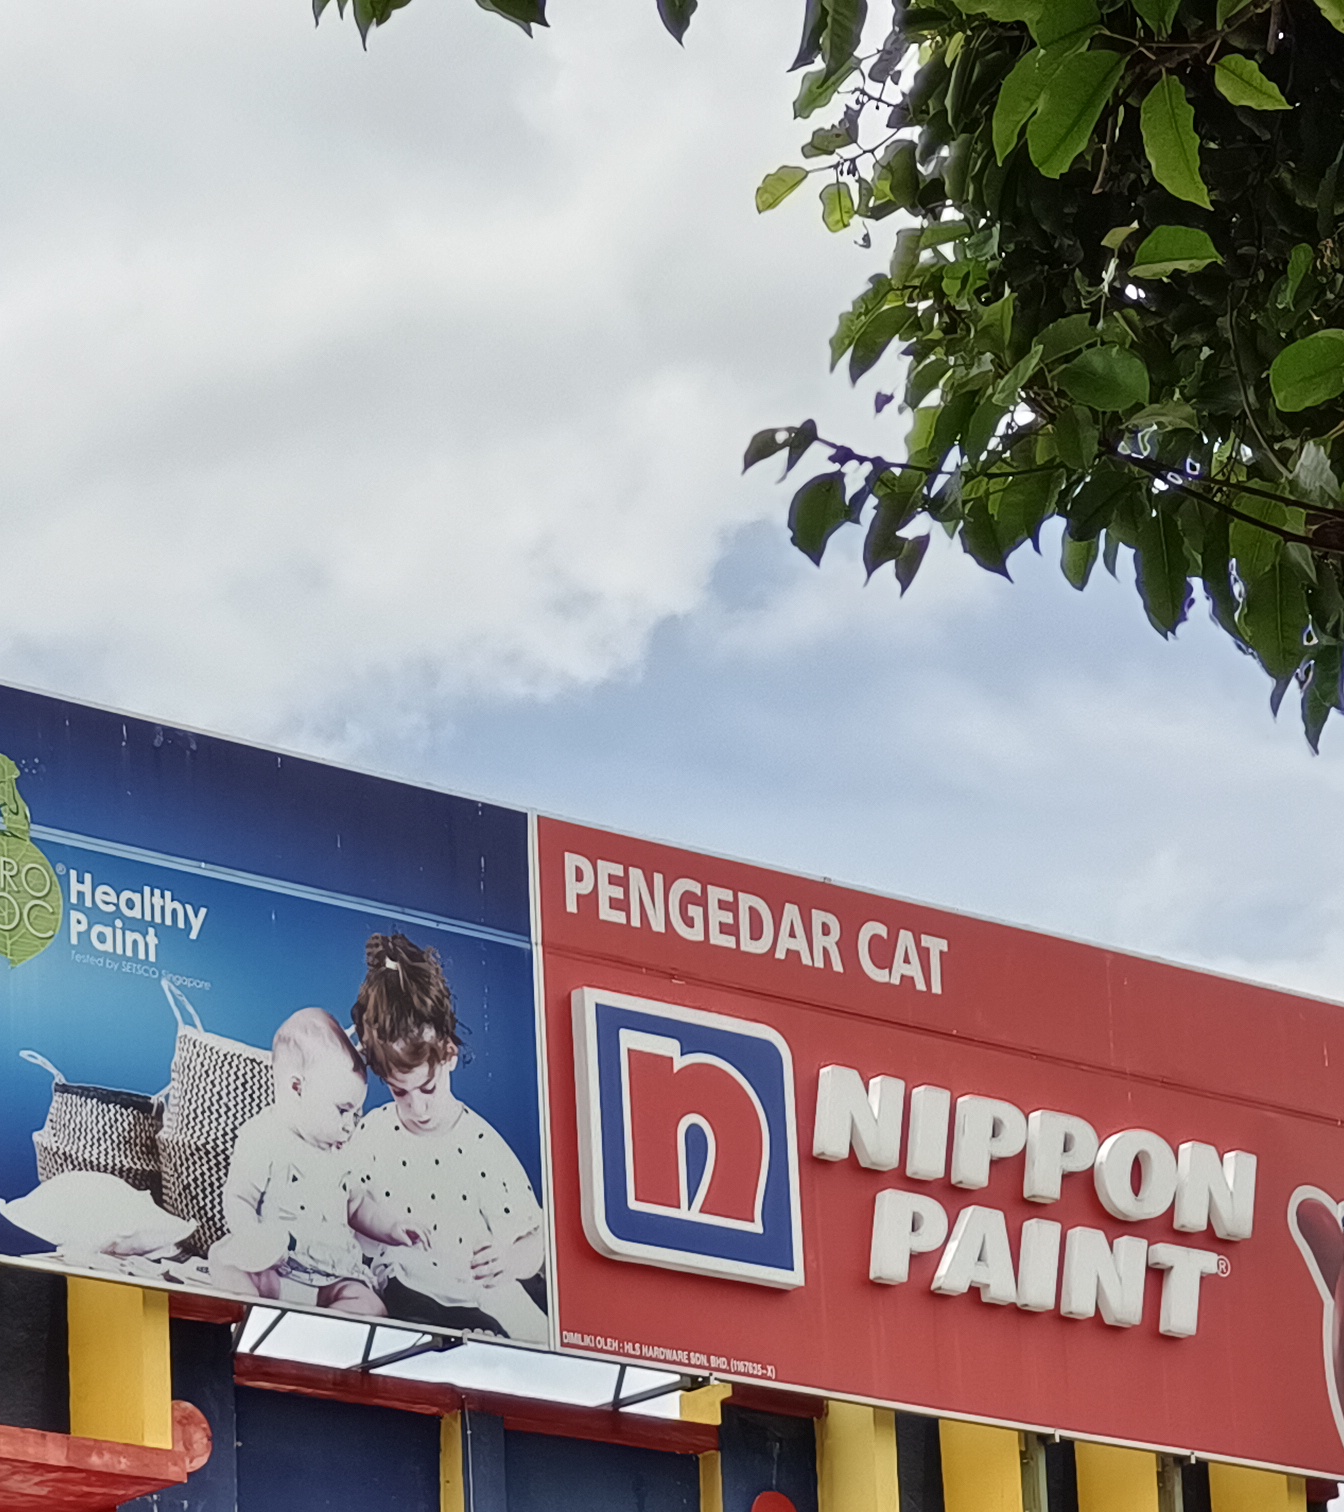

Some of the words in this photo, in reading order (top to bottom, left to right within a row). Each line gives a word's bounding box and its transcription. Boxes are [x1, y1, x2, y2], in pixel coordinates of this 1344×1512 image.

[69, 869, 207, 940] Healthy
[69, 909, 159, 963] Paint
[563, 850, 843, 976] PENGEDAR
[856, 920, 949, 996] CAT
[70, 950, 104, 967] Tested
[105, 955, 120, 973] by
[160, 969, 212, 991] Singapore
[813, 1063, 1257, 1242] NIPPON
[867, 1186, 1221, 1340] PAINT
[596, 1337, 619, 1351] OLEH
[624, 1341, 641, 1356] HLS
[641, 1344, 688, 1364] HARDWARE
